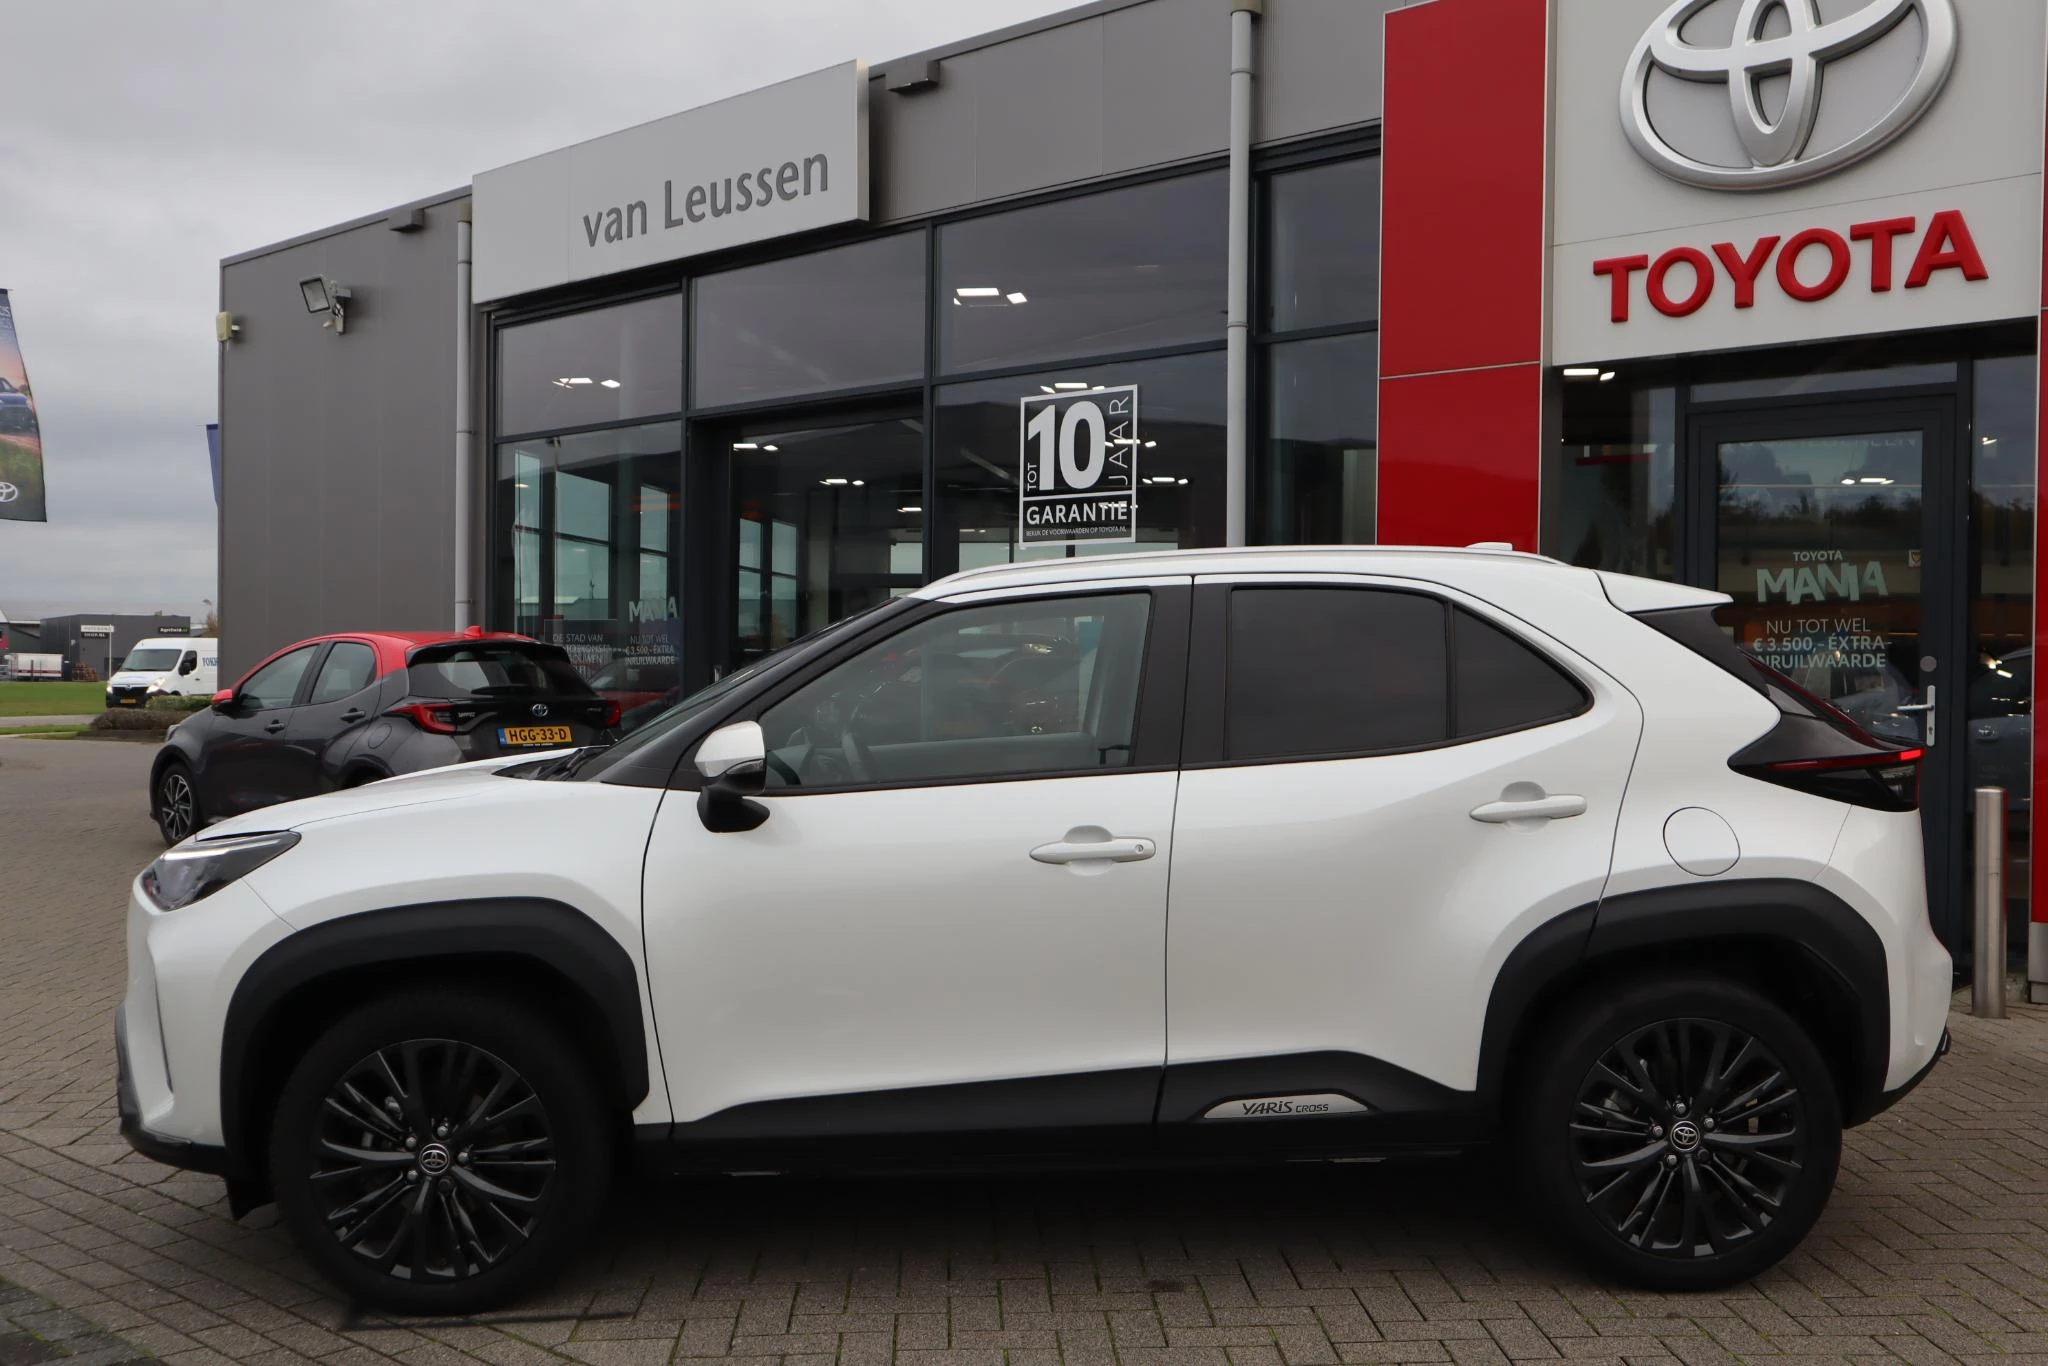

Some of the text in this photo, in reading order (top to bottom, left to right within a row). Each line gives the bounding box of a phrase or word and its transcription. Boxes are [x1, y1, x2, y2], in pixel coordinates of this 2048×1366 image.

[583, 153, 828, 247] van Leussen
[1593, 209, 1989, 323] TOYOTA
[1027, 400, 1106, 491] 10
[1108, 396, 1129, 486] JAAR
[1027, 462, 1037, 492] TOT
[1026, 501, 1128, 525] GARANTIE
[1793, 550, 1843, 562] TOYOTA
[1756, 560, 1889, 605] MANIA
[552, 633, 604, 642] DE STAD VAN
[1766, 617, 1871, 634] NU TOT WEL
[1754, 653, 1886, 669] NRUILWAARDE
[508, 728, 567, 742] HGG-33-D
[1296, 1103, 1329, 1113] CROSS
